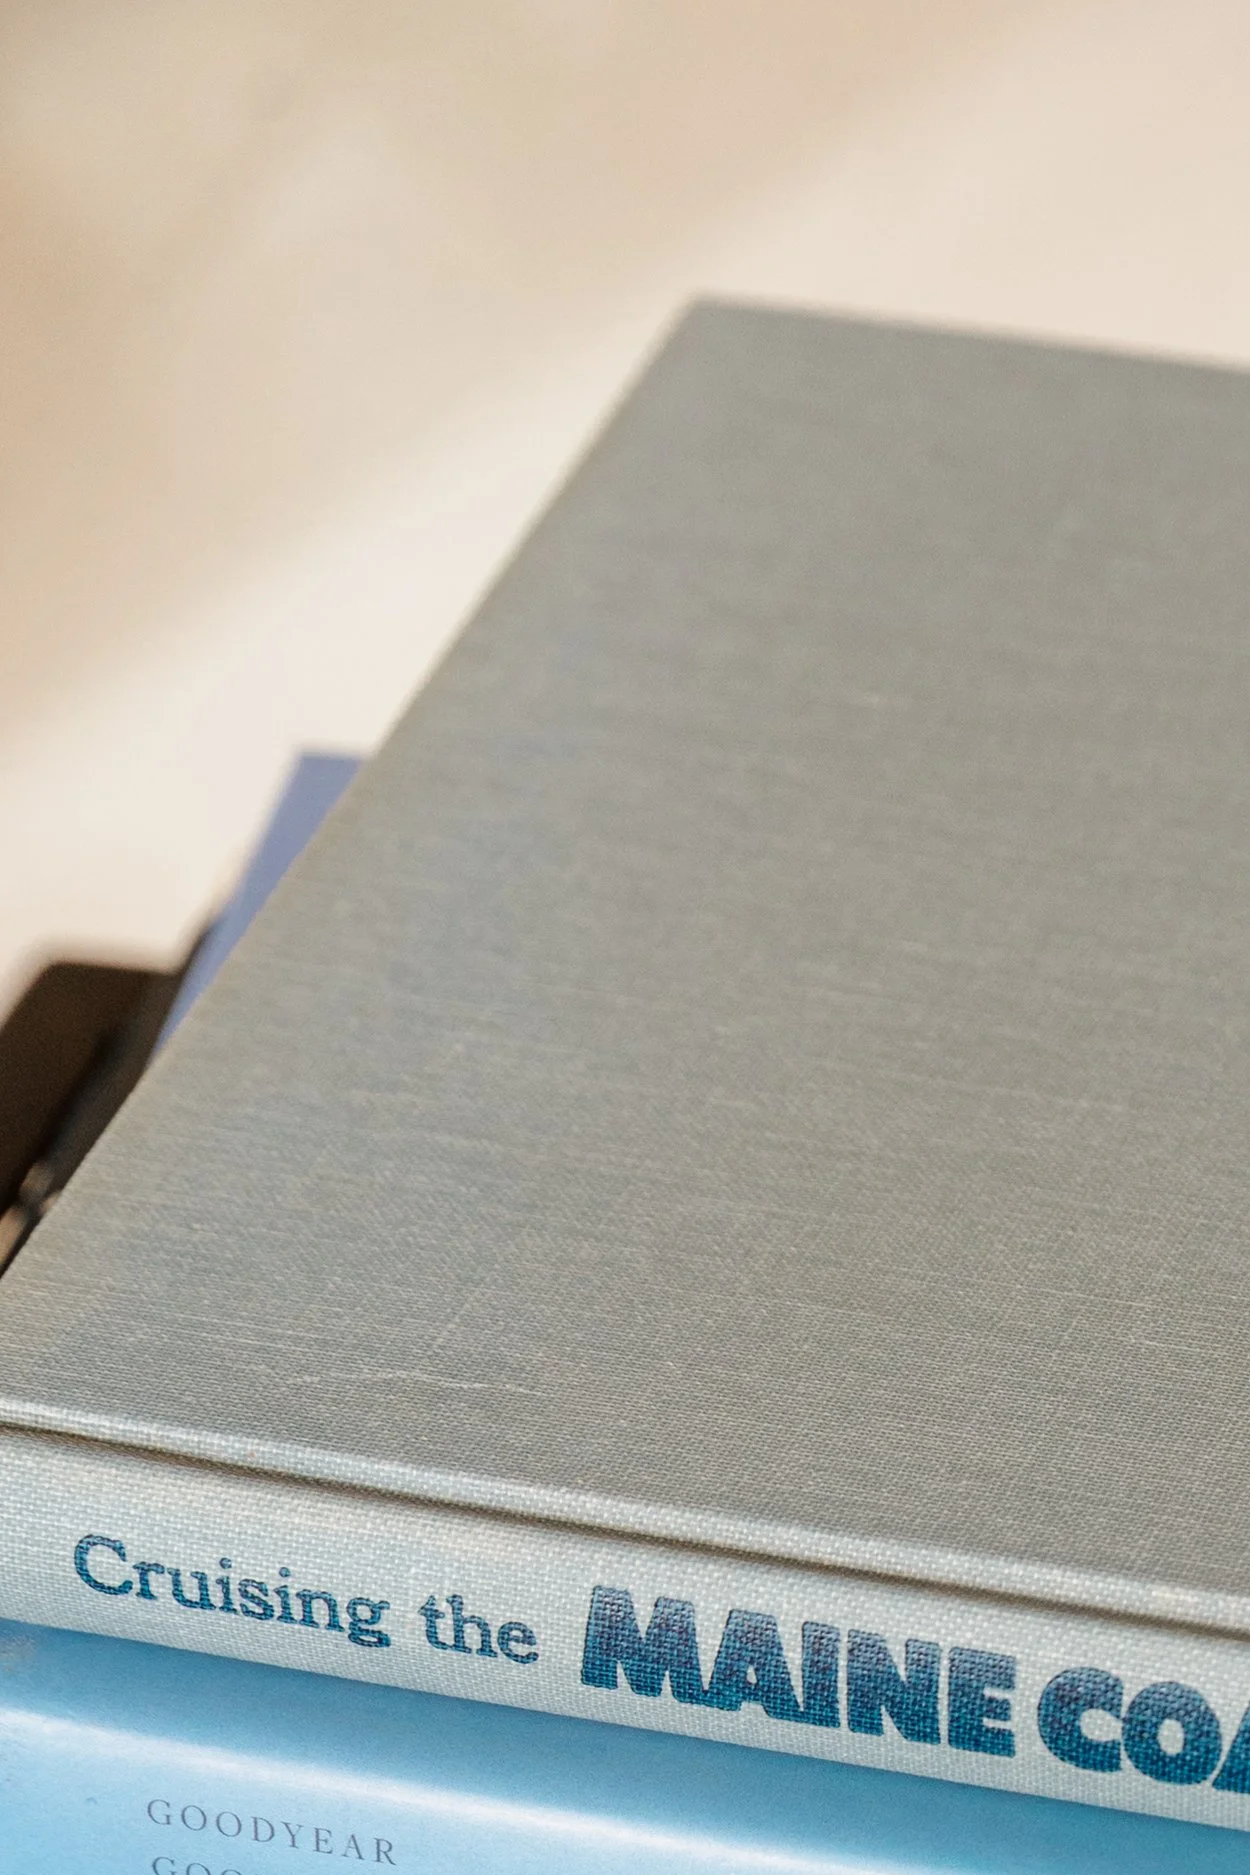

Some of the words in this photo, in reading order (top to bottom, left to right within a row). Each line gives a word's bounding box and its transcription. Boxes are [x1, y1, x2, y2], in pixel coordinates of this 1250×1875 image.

[75, 1534, 390, 1648] Cruising
[419, 1594, 540, 1664] the
[580, 1585, 1017, 1758] MAINE
[146, 1798, 398, 1866] GOODYEAR
